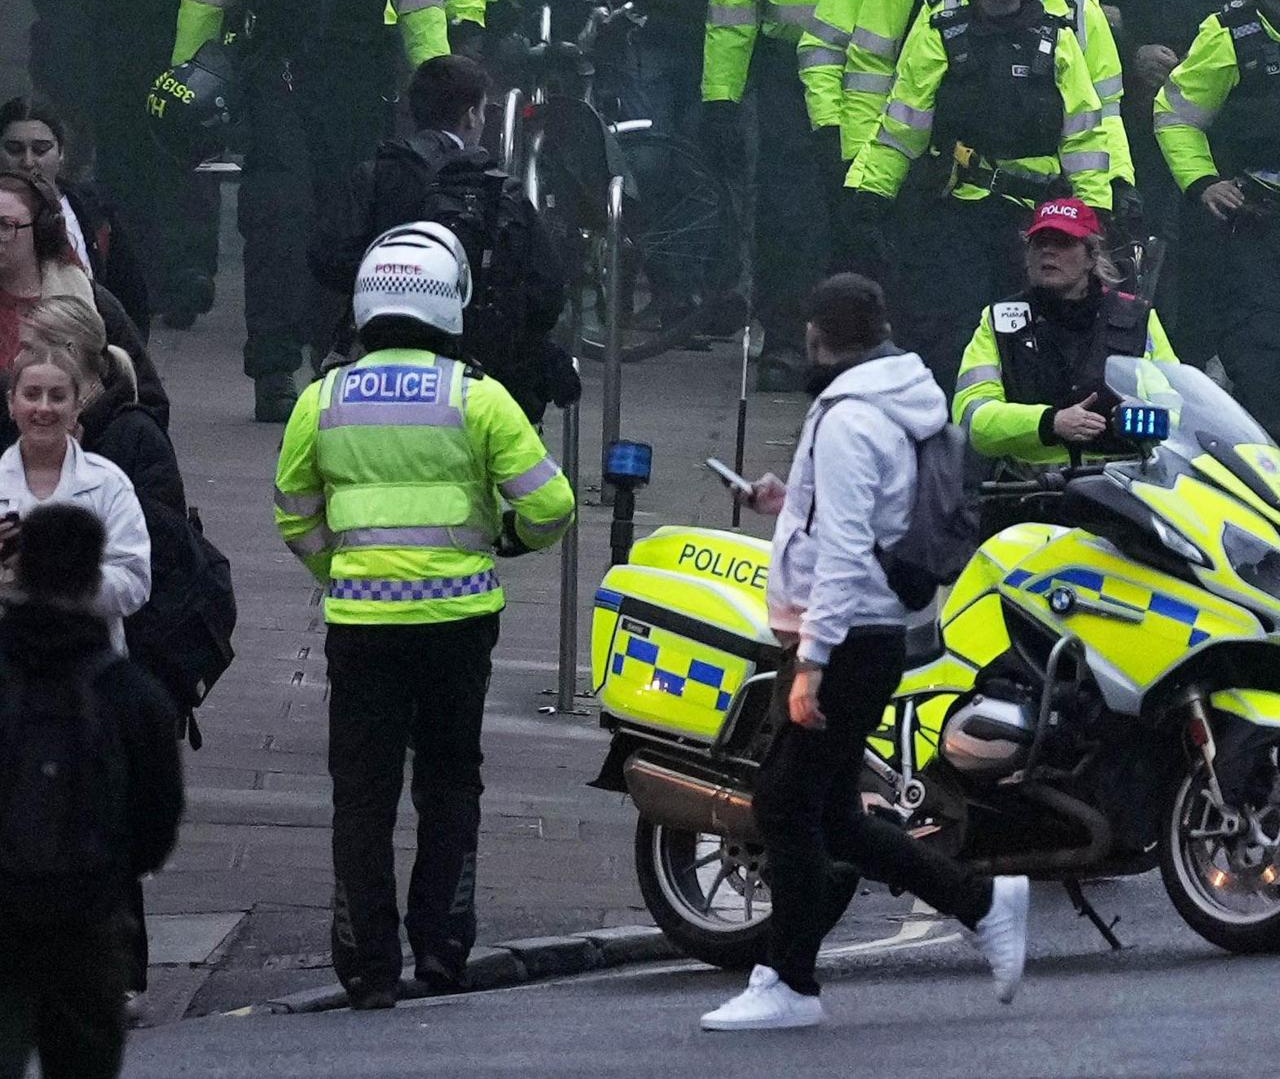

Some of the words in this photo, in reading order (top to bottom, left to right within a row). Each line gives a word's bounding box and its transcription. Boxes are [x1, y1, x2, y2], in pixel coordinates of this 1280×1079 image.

[1041, 205, 1078, 219] POLICE
[375, 263, 423, 275] POLICE
[1011, 320, 1018, 329] 6
[343, 371, 438, 398] POLICE
[678, 543, 769, 590] POLICE
